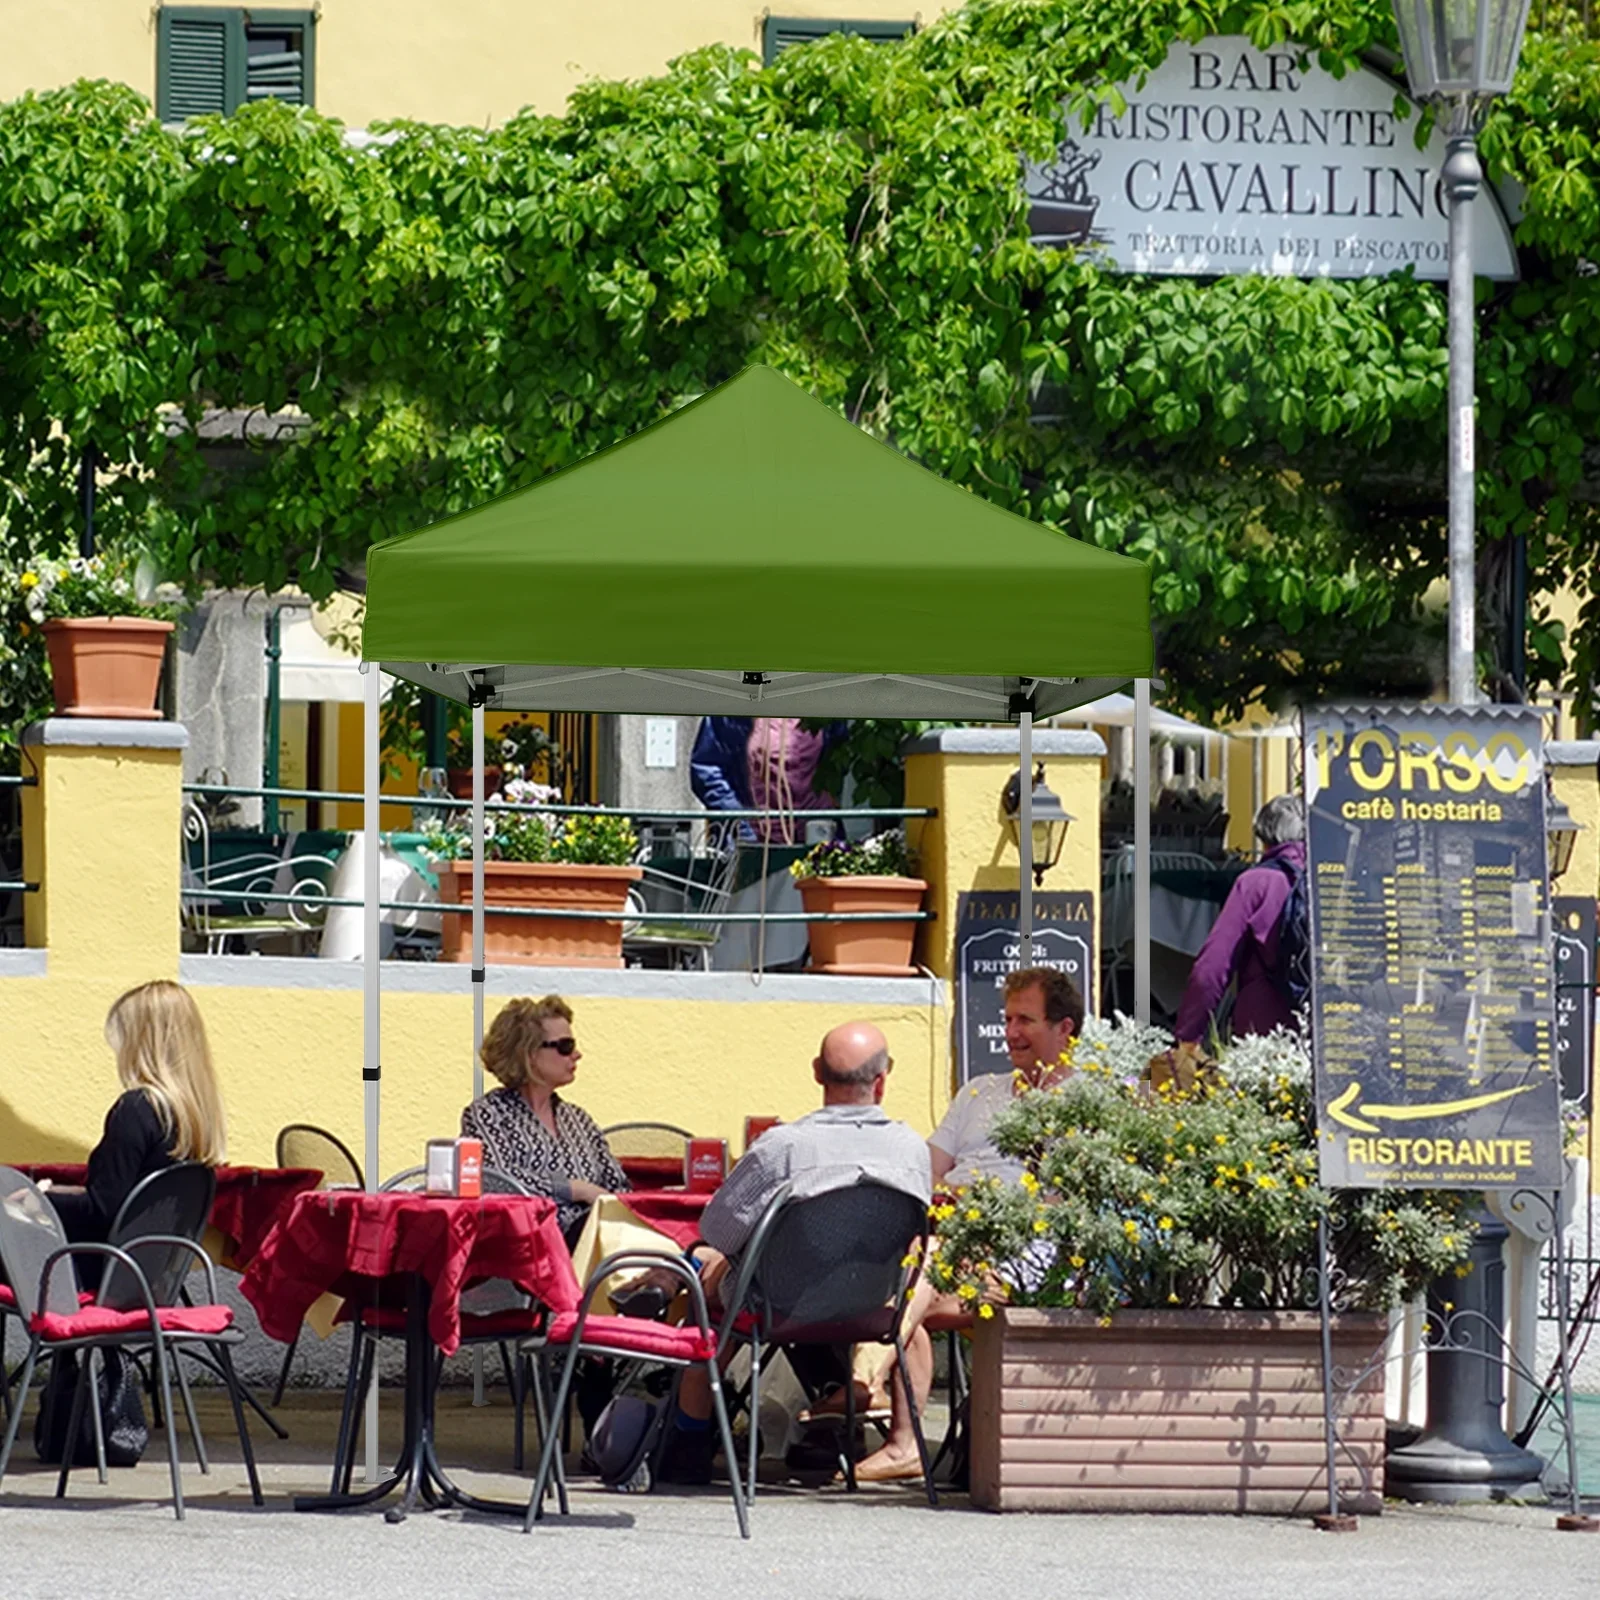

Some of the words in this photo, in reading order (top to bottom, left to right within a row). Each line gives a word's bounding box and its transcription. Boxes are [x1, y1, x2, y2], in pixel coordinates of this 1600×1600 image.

[1189, 52, 1300, 92] BAR
[1092, 101, 1396, 147] RISTORANTE
[1128, 232, 1264, 256] TRATTORIA
[1279, 236, 1321, 259] DEI
[1401, 798, 1502, 821] hostaria
[1348, 1137, 1532, 1166] RISTORANTE
